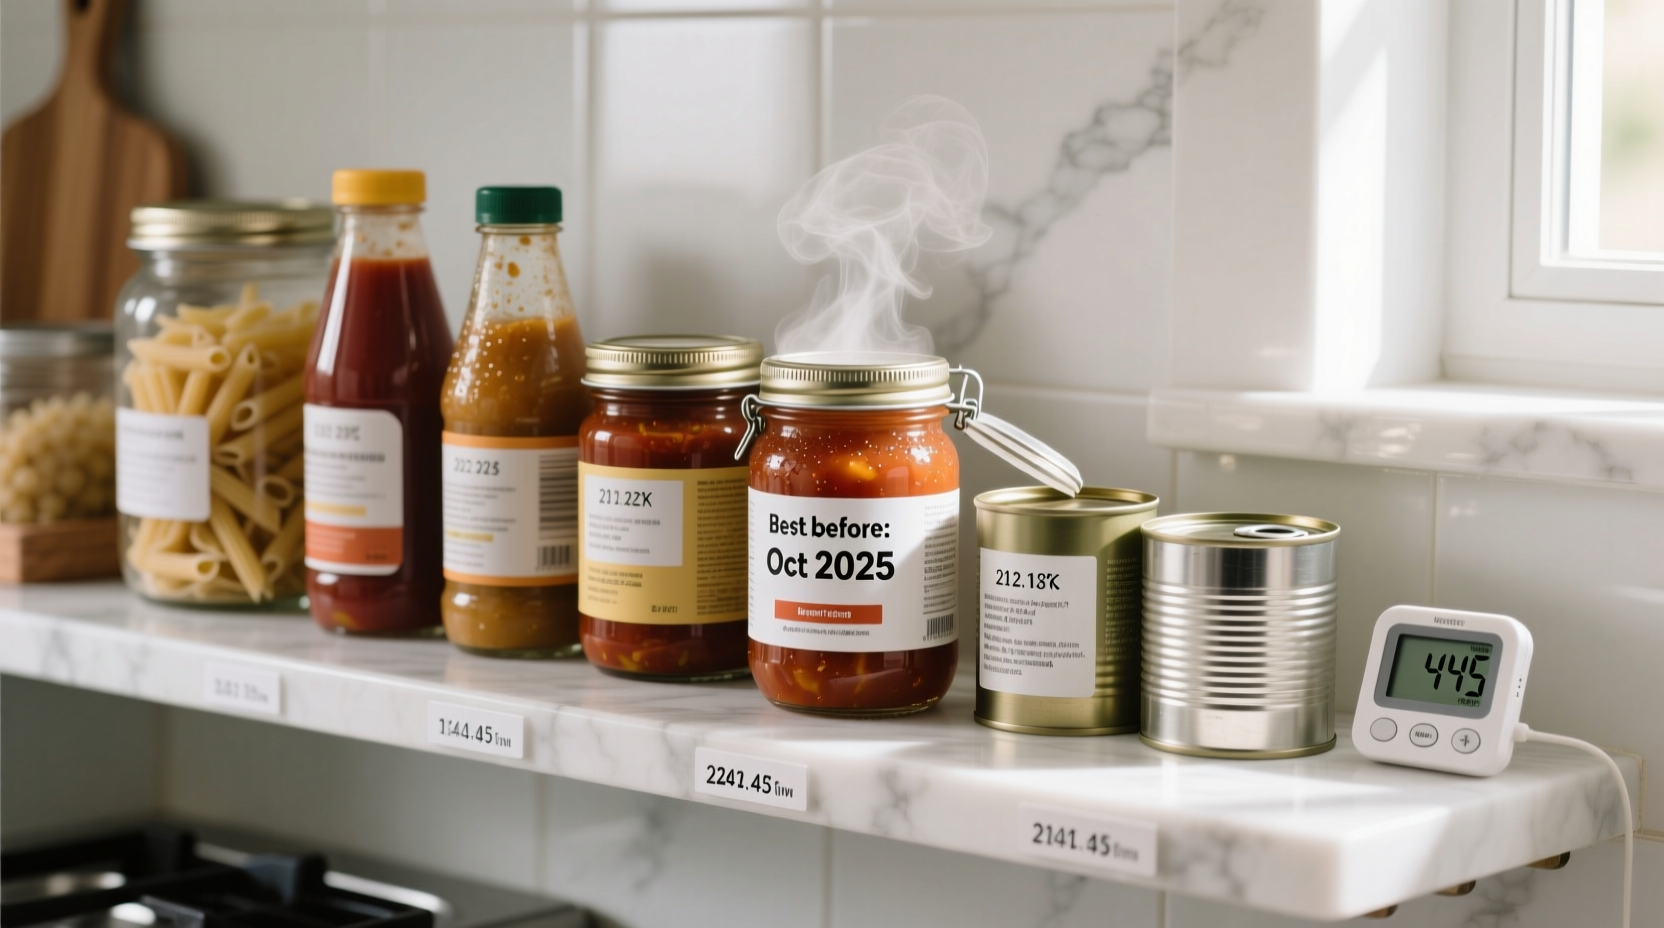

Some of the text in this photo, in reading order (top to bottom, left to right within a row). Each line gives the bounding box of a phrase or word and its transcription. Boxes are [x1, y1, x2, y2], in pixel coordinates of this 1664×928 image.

[769, 513, 890, 538] Best before:
[766, 547, 895, 581] Oct 2025
[1424, 652, 1490, 698] 445
